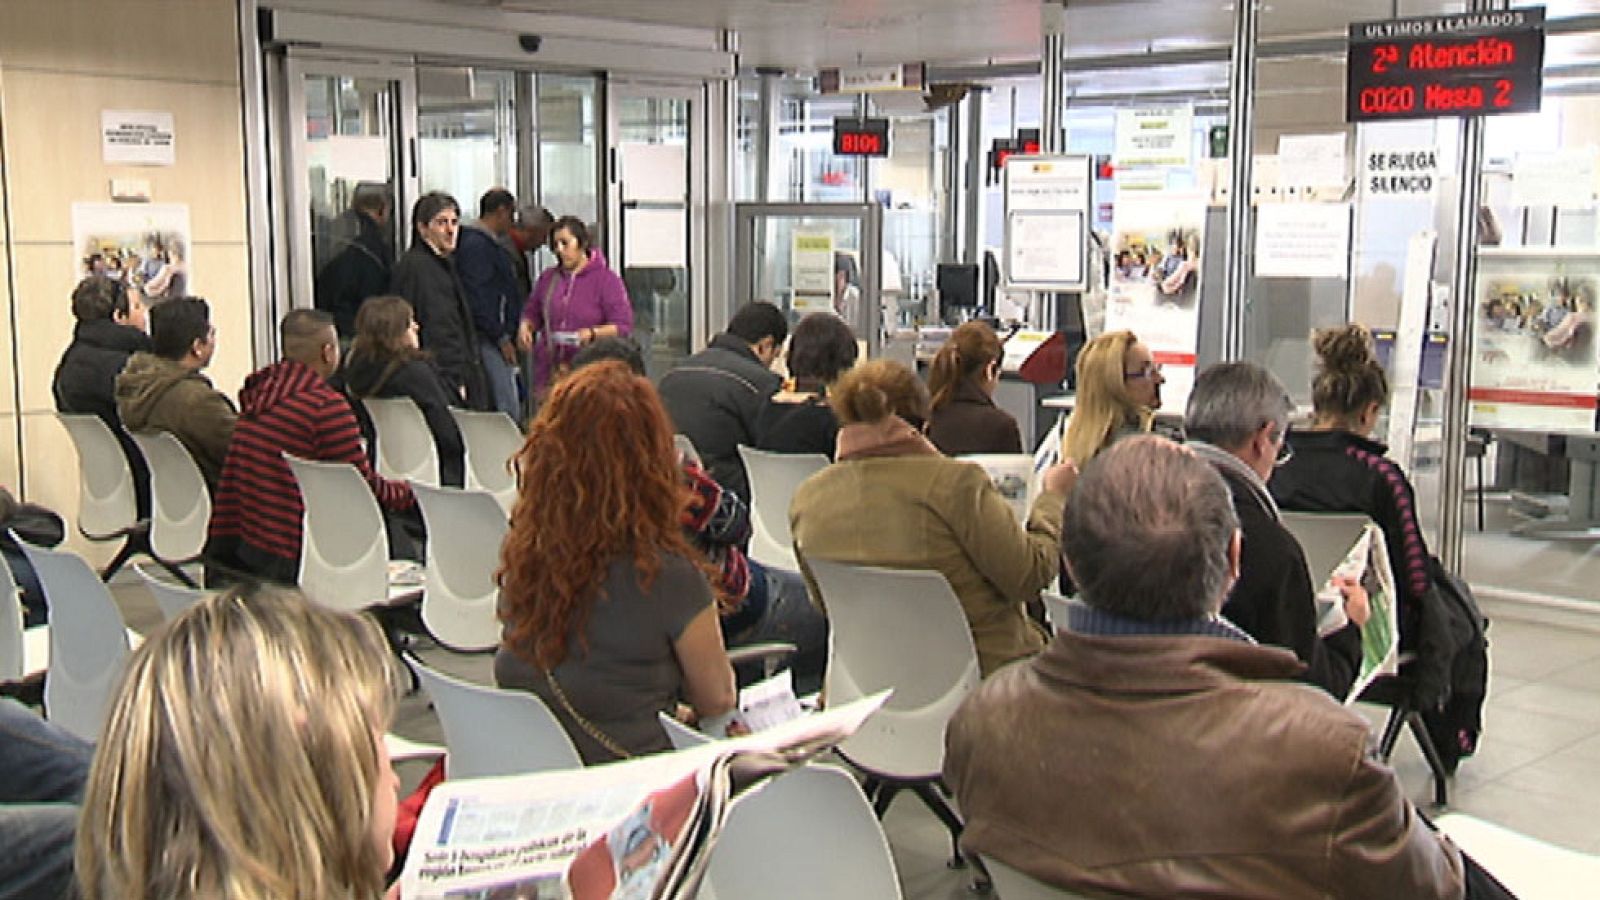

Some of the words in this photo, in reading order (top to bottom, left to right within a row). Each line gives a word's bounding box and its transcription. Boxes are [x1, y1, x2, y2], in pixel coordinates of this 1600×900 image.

[1366, 21, 1432, 37] ULTIMOS
[1437, 13, 1523, 31] LLAMADOS
[1409, 38, 1514, 69] Atención
[1360, 85, 1415, 113] C020
[1425, 84, 1484, 110] Mesa
[1493, 79, 1514, 108] 2
[1368, 152, 1385, 171] SE
[1389, 151, 1437, 171] RUEGA
[1370, 175, 1433, 194] SILENCIO
